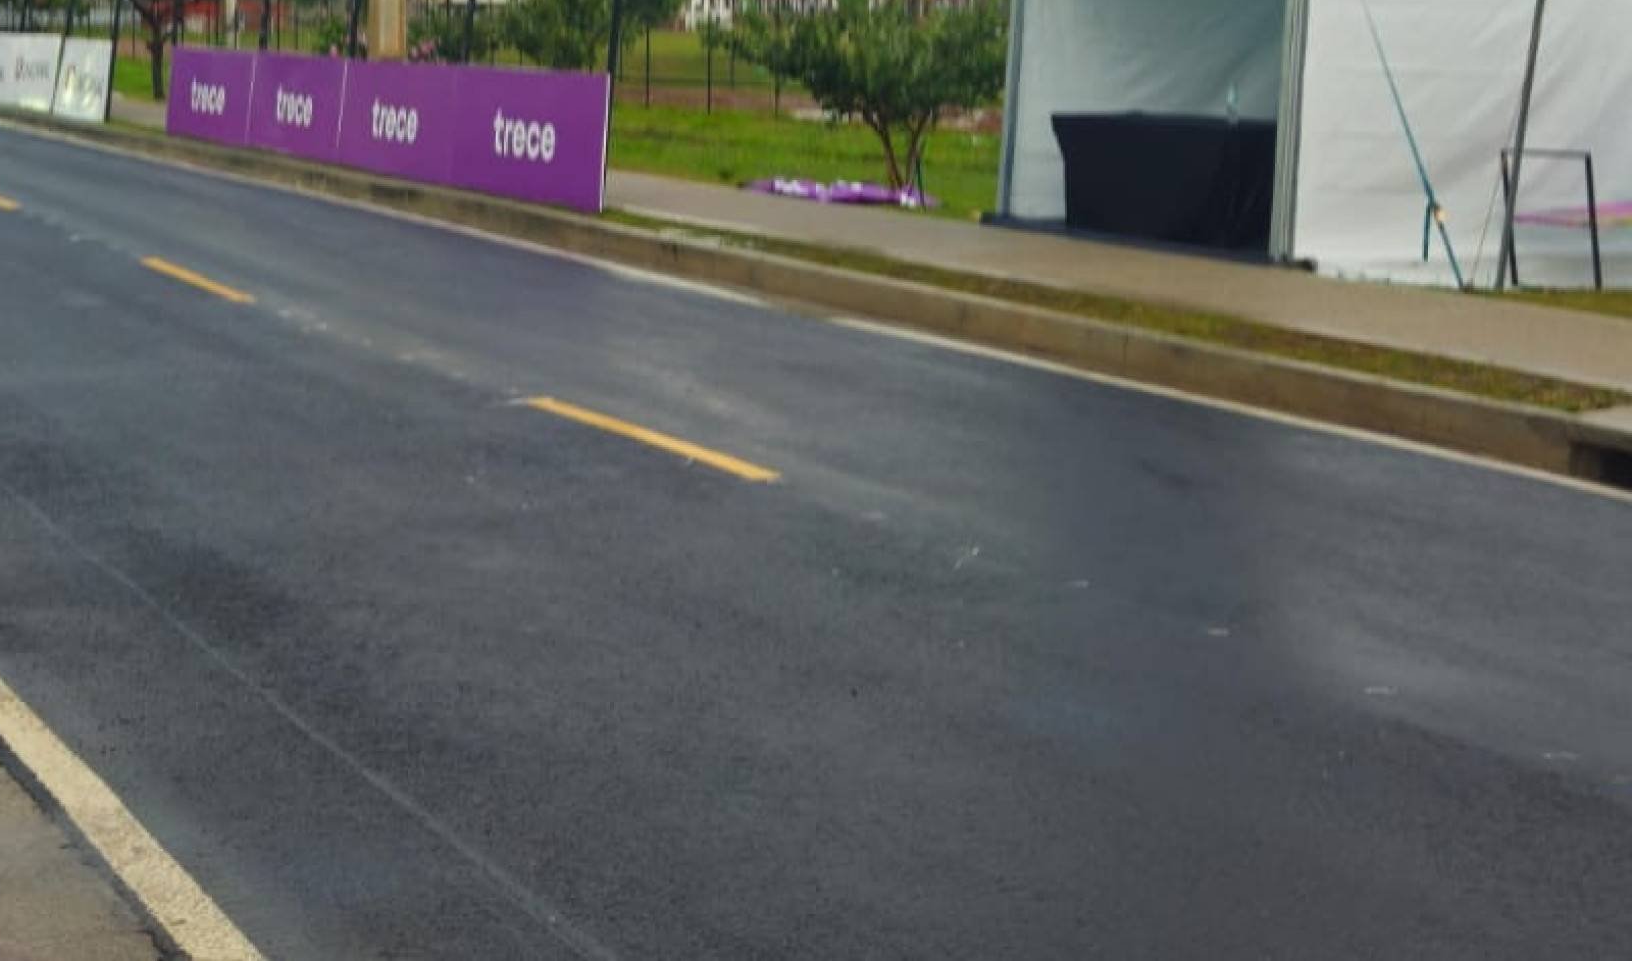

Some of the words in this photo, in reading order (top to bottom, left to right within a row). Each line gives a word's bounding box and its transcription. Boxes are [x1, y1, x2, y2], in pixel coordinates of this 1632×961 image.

[191, 77, 226, 115] trece
[276, 84, 313, 127] trece
[371, 98, 418, 144] trece
[493, 109, 556, 163] trece
